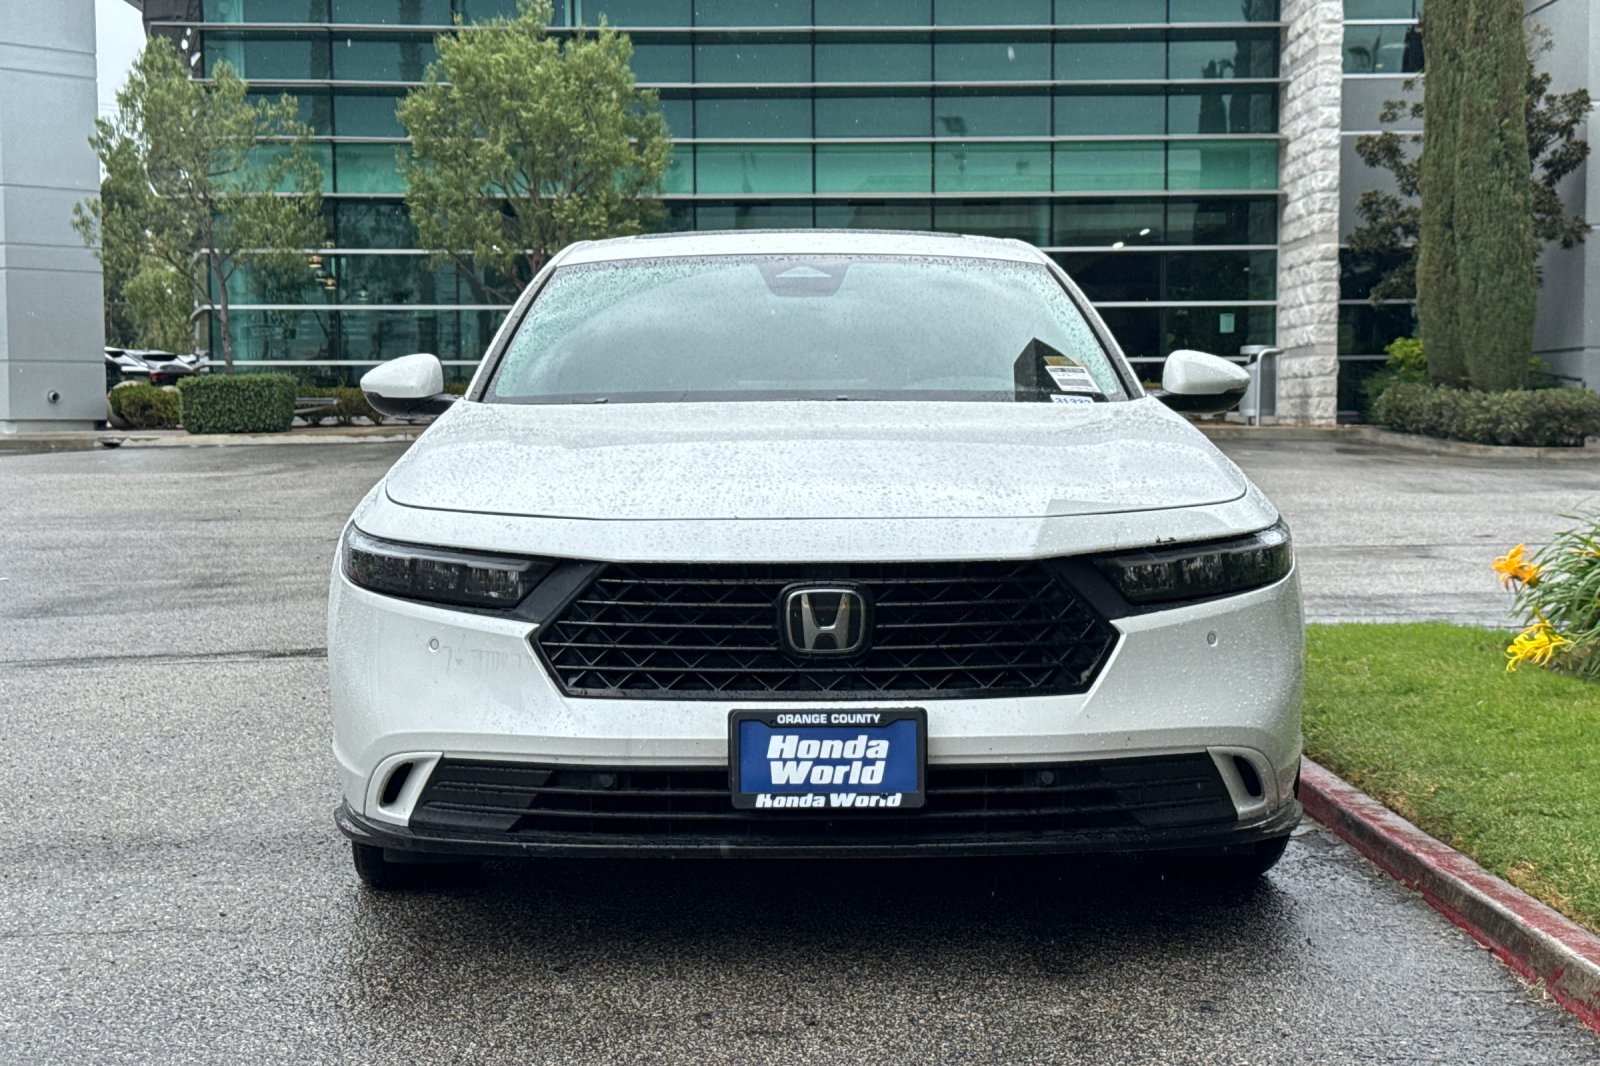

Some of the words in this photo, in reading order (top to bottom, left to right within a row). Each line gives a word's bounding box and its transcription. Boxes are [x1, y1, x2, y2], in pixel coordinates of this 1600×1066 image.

[776, 713, 828, 724] ORANGE
[831, 713, 881, 724] COUNTY
[766, 735, 889, 759] Honda
[770, 760, 886, 785] World
[755, 793, 826, 808] Honda
